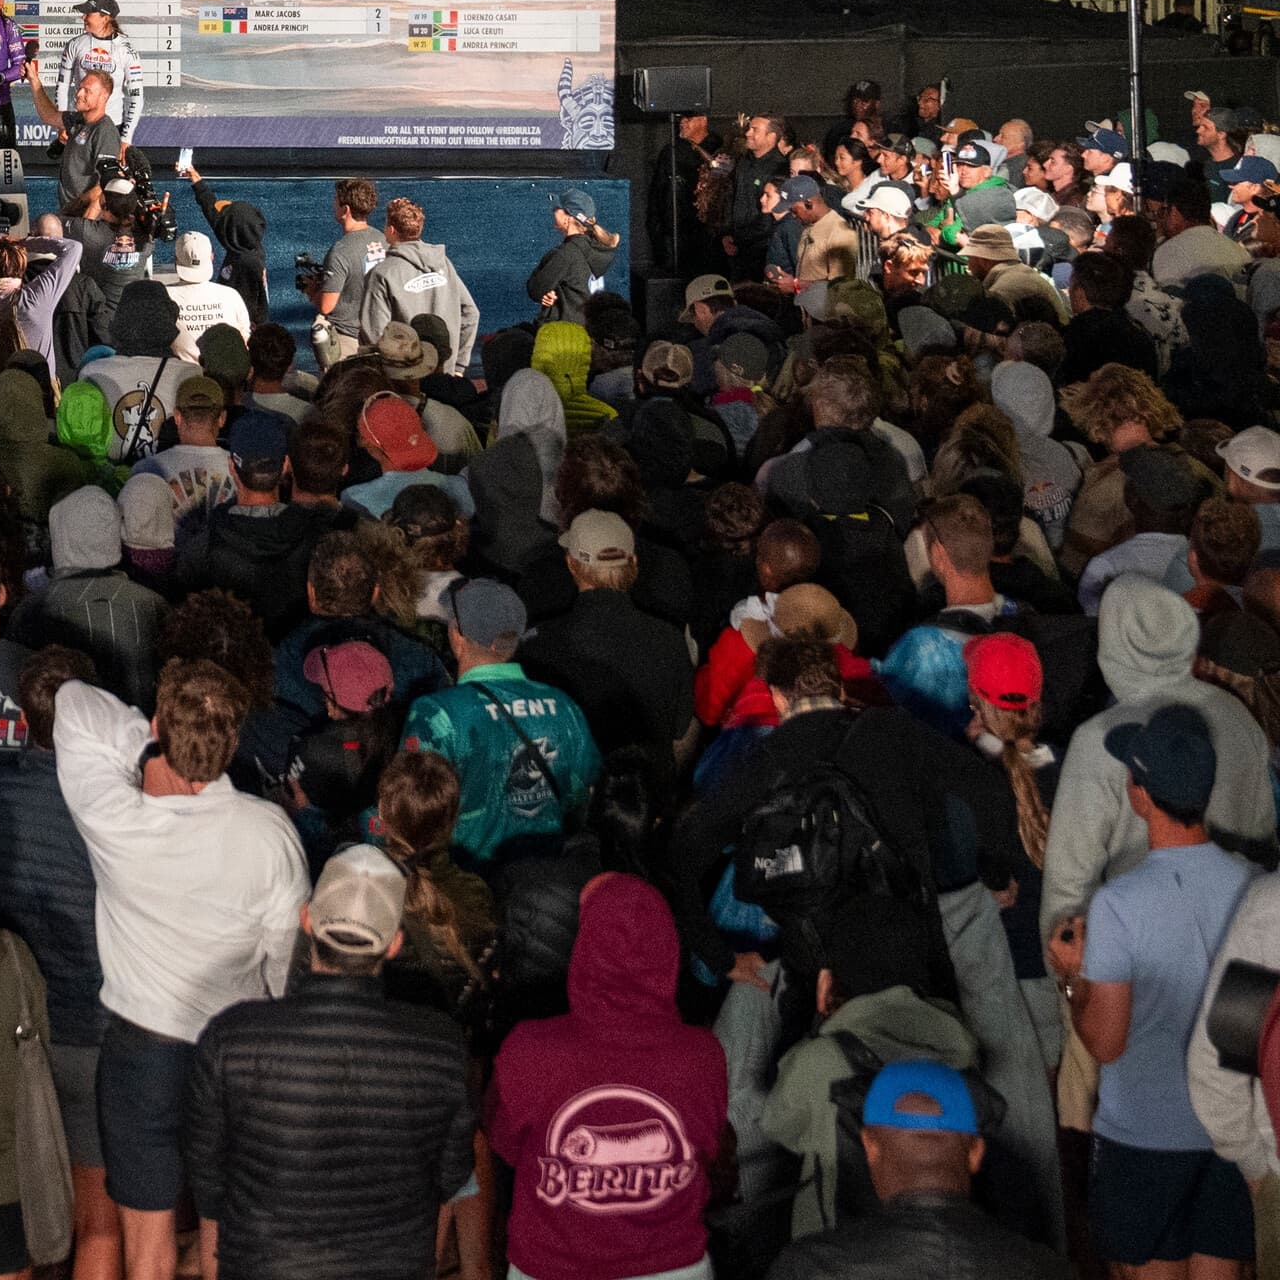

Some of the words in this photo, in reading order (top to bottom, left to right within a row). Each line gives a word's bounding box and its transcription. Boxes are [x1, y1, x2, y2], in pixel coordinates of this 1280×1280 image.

[385, 126, 397, 134] FOR
[400, 126, 411, 134] ALL
[413, 126, 425, 134] THE
[427, 126, 447, 135] EVENT
[467, 127, 493, 135] FOLLOW
[448, 137, 462, 145] OUT
[464, 137, 484, 145] WHEN
[487, 137, 498, 145] THE
[500, 137, 520, 145] EVENT
[522, 137, 529, 145] IS
[530, 137, 541, 145] ON
[186, 303, 221, 311] CULTURE
